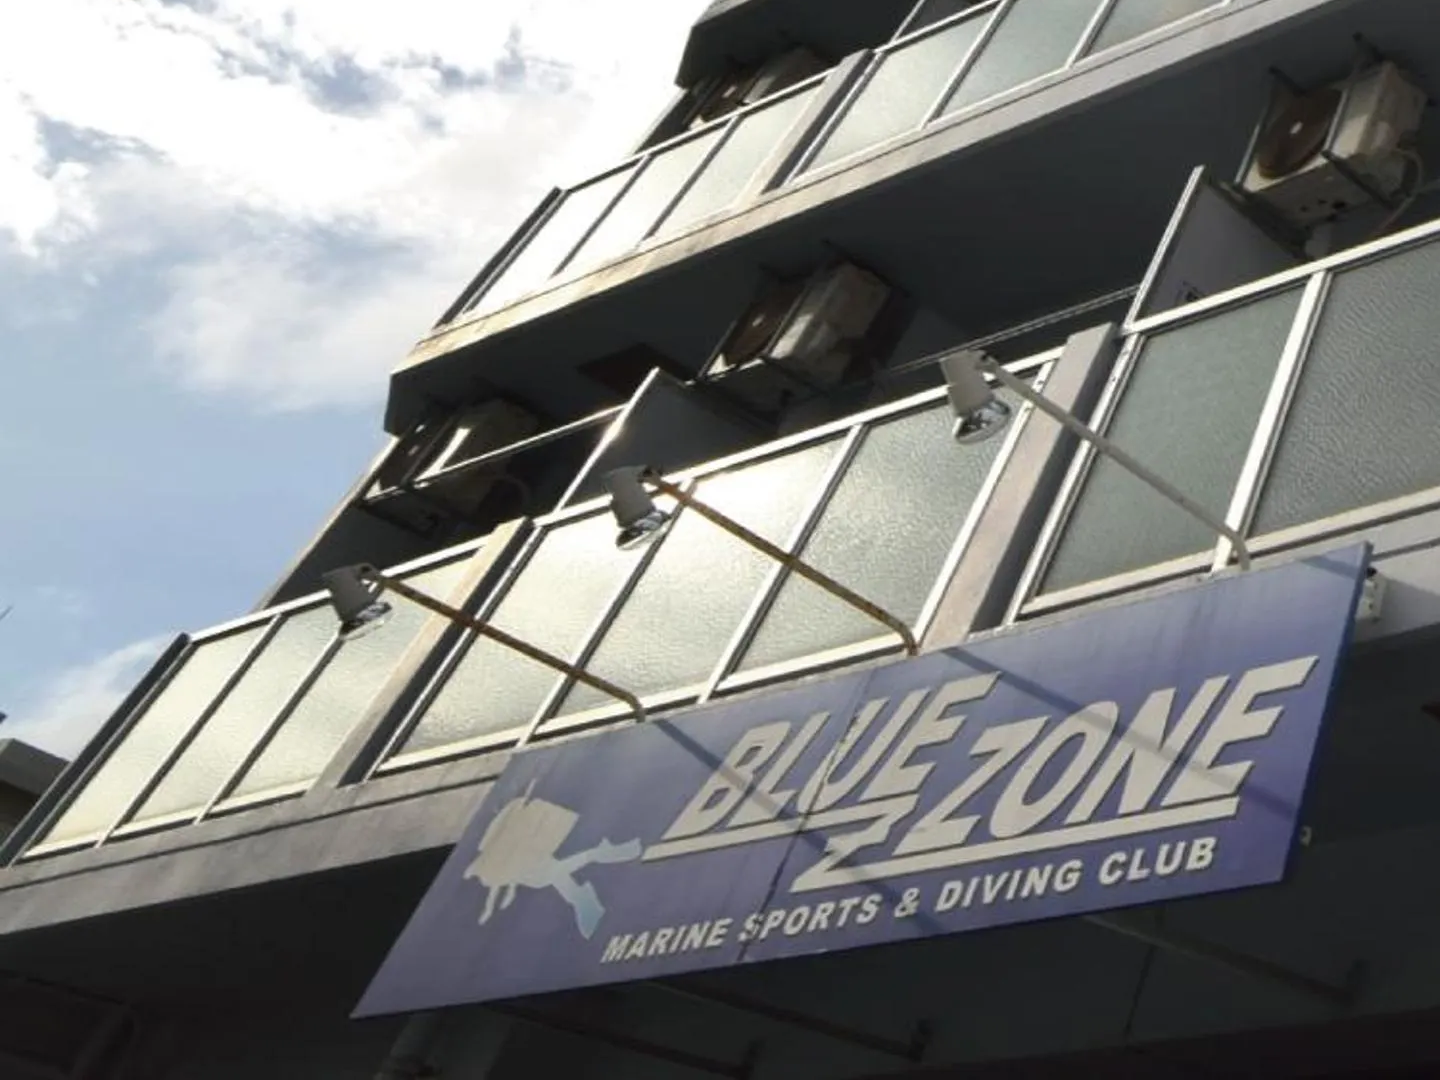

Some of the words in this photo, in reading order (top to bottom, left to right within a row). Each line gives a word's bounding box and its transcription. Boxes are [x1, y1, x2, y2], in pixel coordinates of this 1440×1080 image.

[660, 670, 1000, 840] BLUE
[892, 655, 1319, 856] ZONE
[600, 918, 733, 964] MARINE
[738, 894, 882, 943] SPORTS
[894, 887, 920, 917] &
[935, 859, 1083, 912] DIVING
[1100, 836, 1217, 885] CLUB
